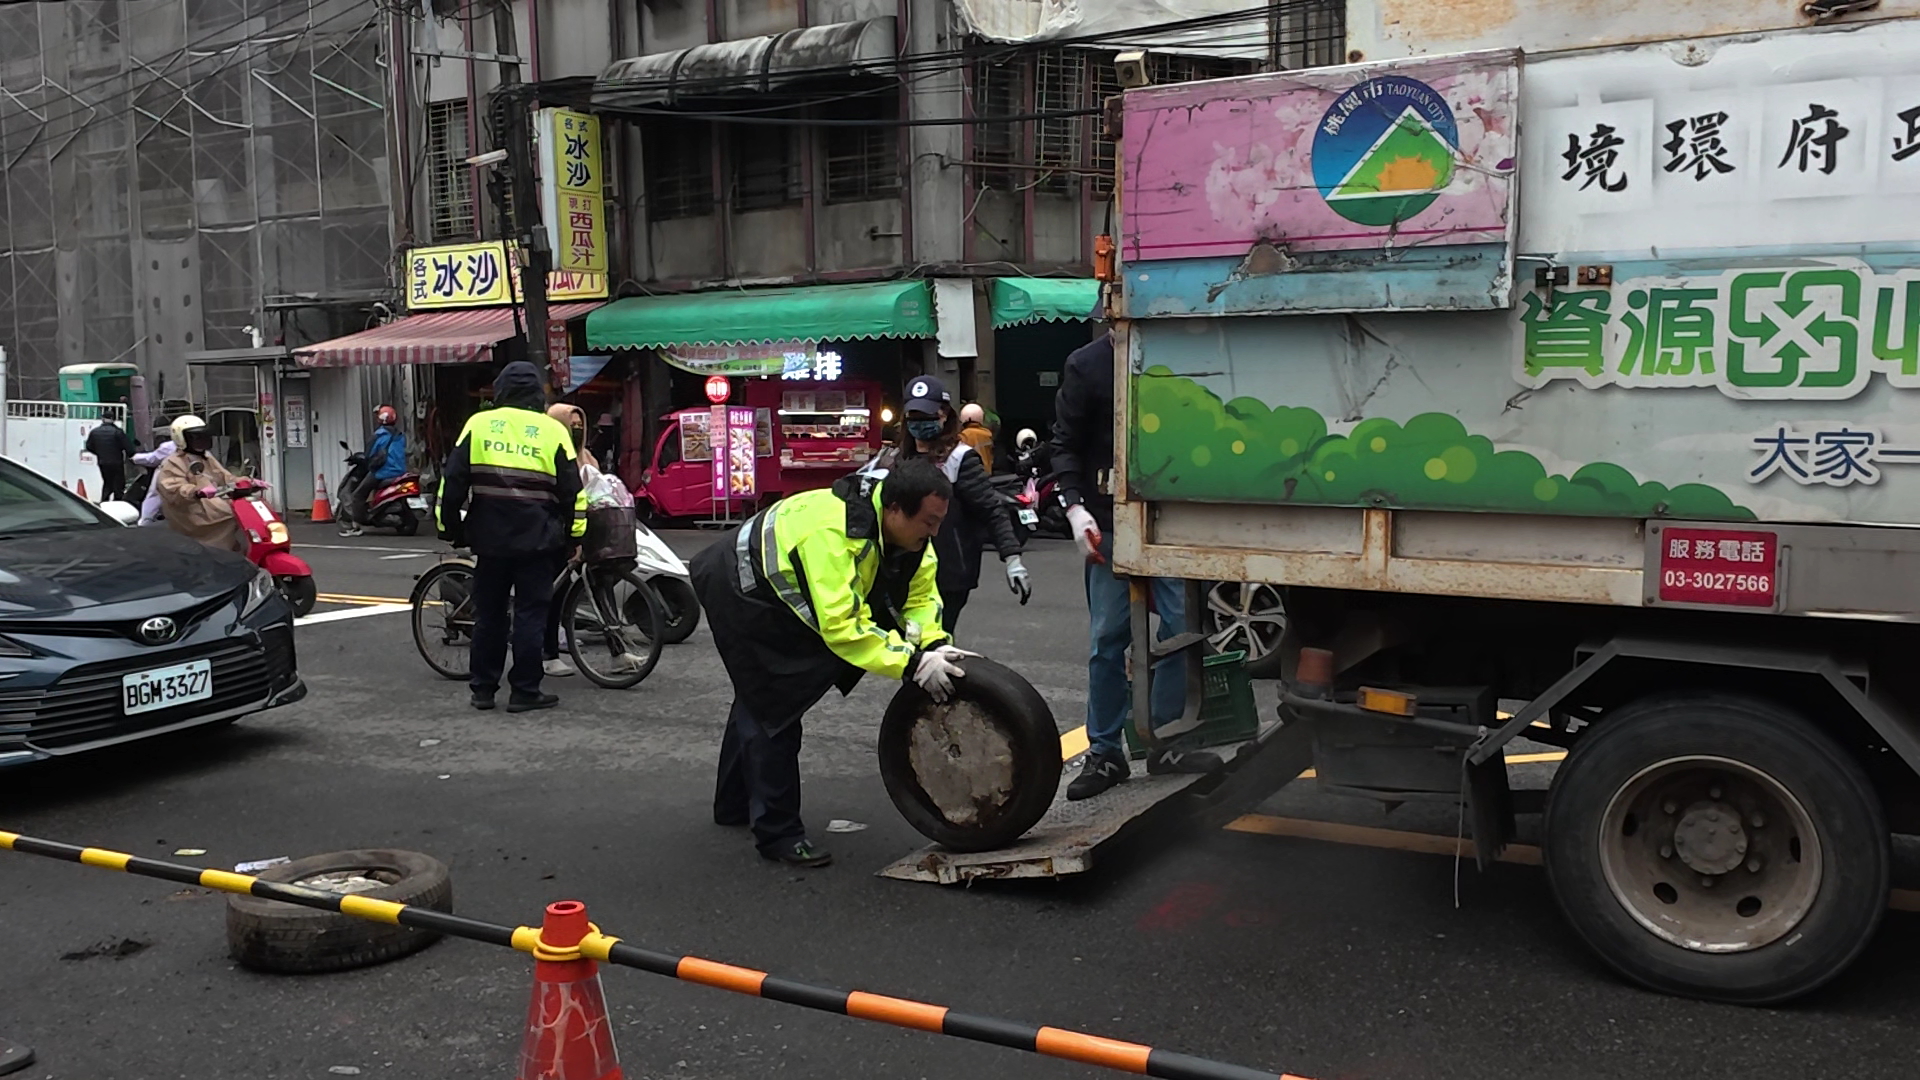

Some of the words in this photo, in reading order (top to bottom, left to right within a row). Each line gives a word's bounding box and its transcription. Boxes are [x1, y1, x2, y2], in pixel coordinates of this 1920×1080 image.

[1387, 83, 1431, 105] TAOYUAN
[1427, 102, 1447, 124] CITY
[564, 133, 592, 187] 冰沙
[569, 211, 596, 266] 西瓜汁
[413, 257, 428, 300] 各式
[432, 251, 499, 297] 冰沙
[484, 440, 542, 459] POLICE
[1669, 538, 1766, 563] 服務電話
[1664, 570, 1770, 593] 03-3027566
[126, 669, 210, 709] BGM-3327
